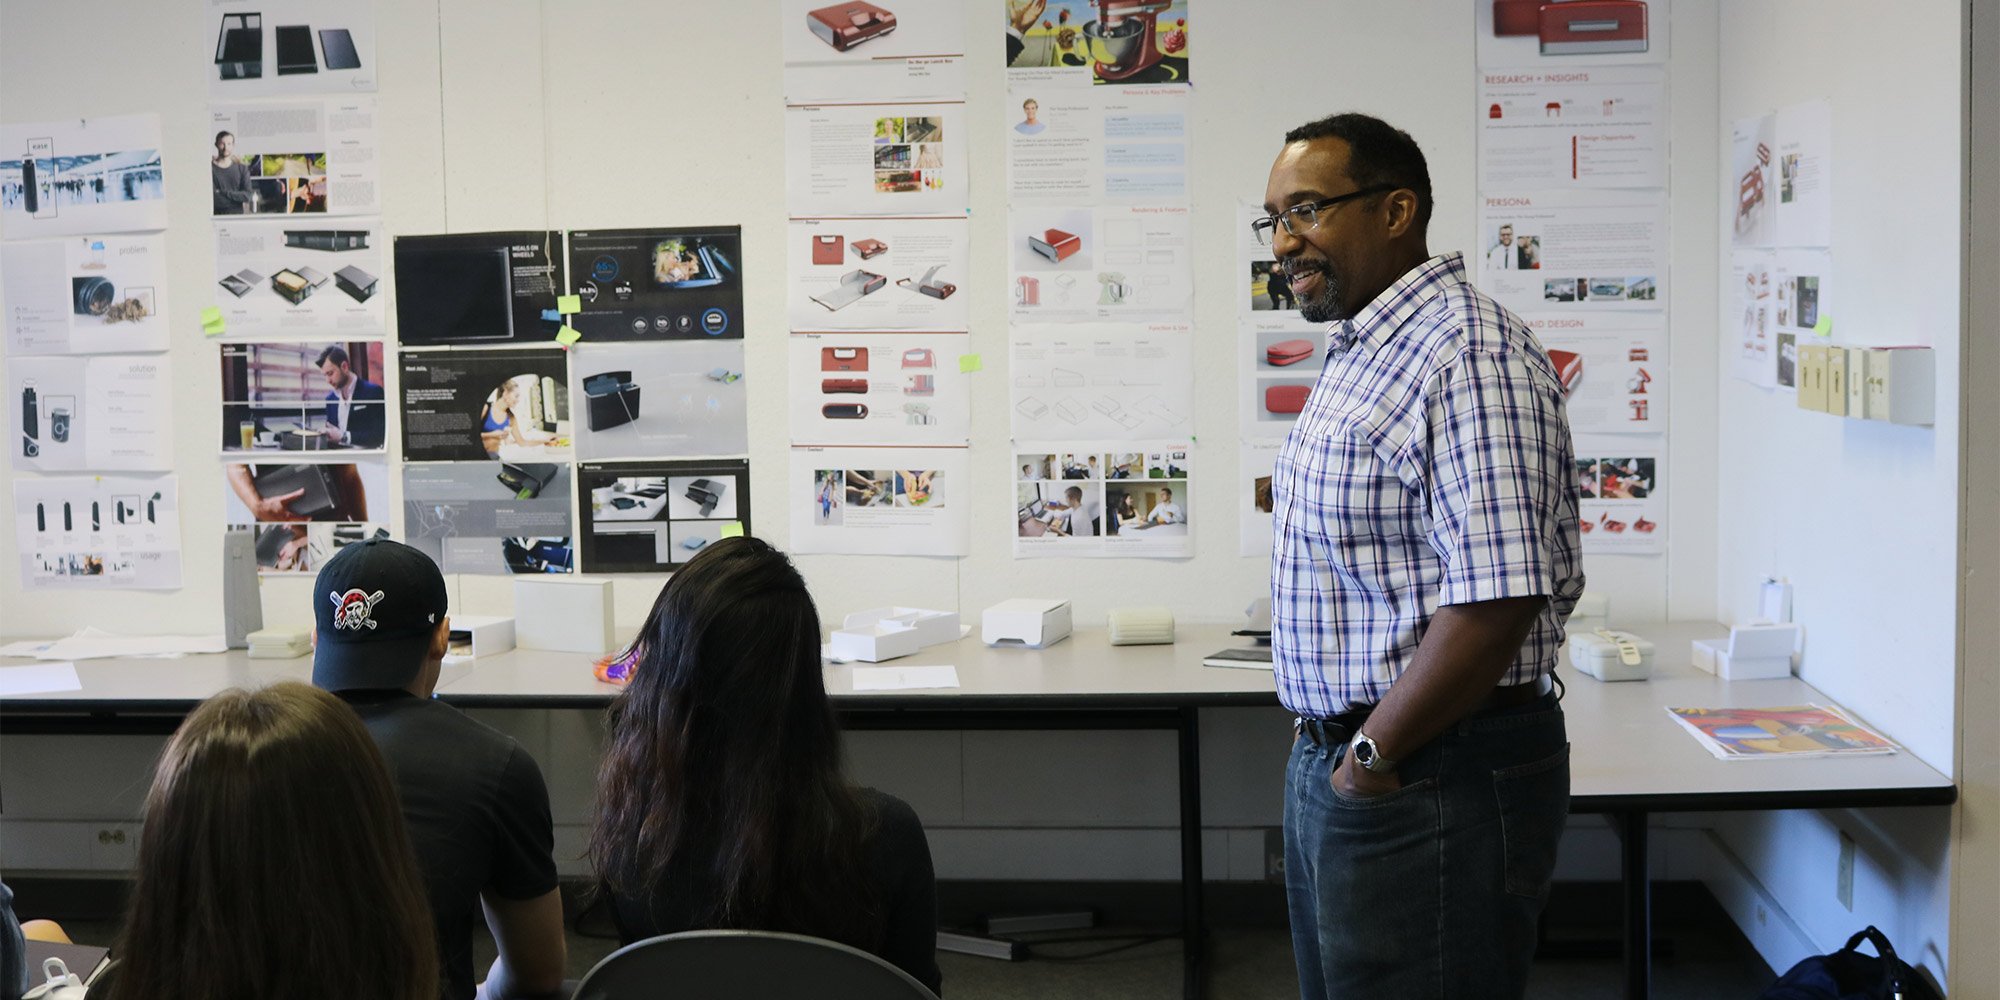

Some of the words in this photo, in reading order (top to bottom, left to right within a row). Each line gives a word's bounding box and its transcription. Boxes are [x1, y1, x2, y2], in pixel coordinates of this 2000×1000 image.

[1485, 75, 1534, 84] RESEARCH
[1545, 73, 1590, 82] INSIGHTS
[1601, 134, 1636, 142] Opportunity
[1486, 197, 1531, 207] PERSONA
[119, 245, 148, 256] problem
[1547, 319, 1585, 328] DESIGN
[129, 364, 157, 373] solution
[140, 553, 162, 562] usage
